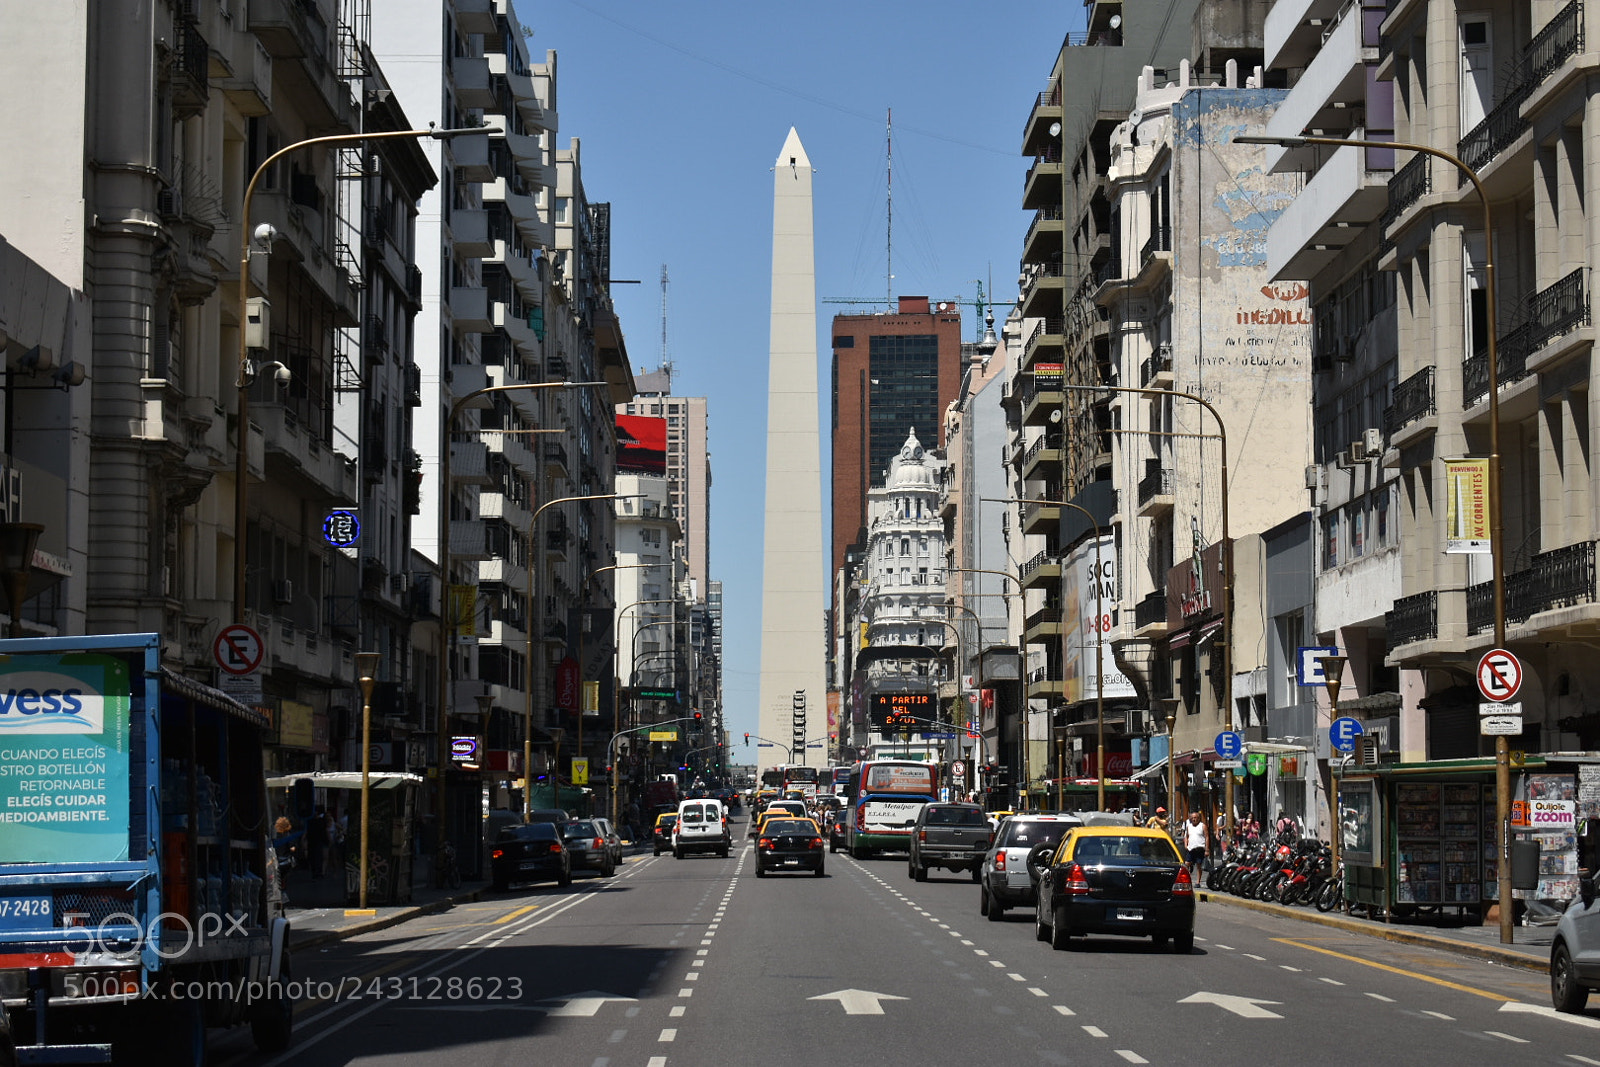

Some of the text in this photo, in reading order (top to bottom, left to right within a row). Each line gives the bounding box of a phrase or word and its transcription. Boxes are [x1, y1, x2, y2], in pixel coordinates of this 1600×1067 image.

[1473, 473, 1484, 538] AV. CORRIENTES
[229, 636, 249, 664] E
[1303, 650, 1331, 683] E
[1491, 661, 1508, 689] E
[892, 696, 929, 704] PARTIR
[1339, 721, 1353, 740] E
[1222, 734, 1233, 749] E
[1, 745, 106, 761] CUANDO ELEGÍS
[38, 761, 105, 776] BOTELLÓN
[20, 779, 106, 791] RETORNABLE
[7, 793, 106, 807] ELEGÍS CUIDAR
[884, 803, 915, 811] Metalpar
[1534, 812, 1572, 822] zoom
[0, 900, 51, 918] 7-2428
